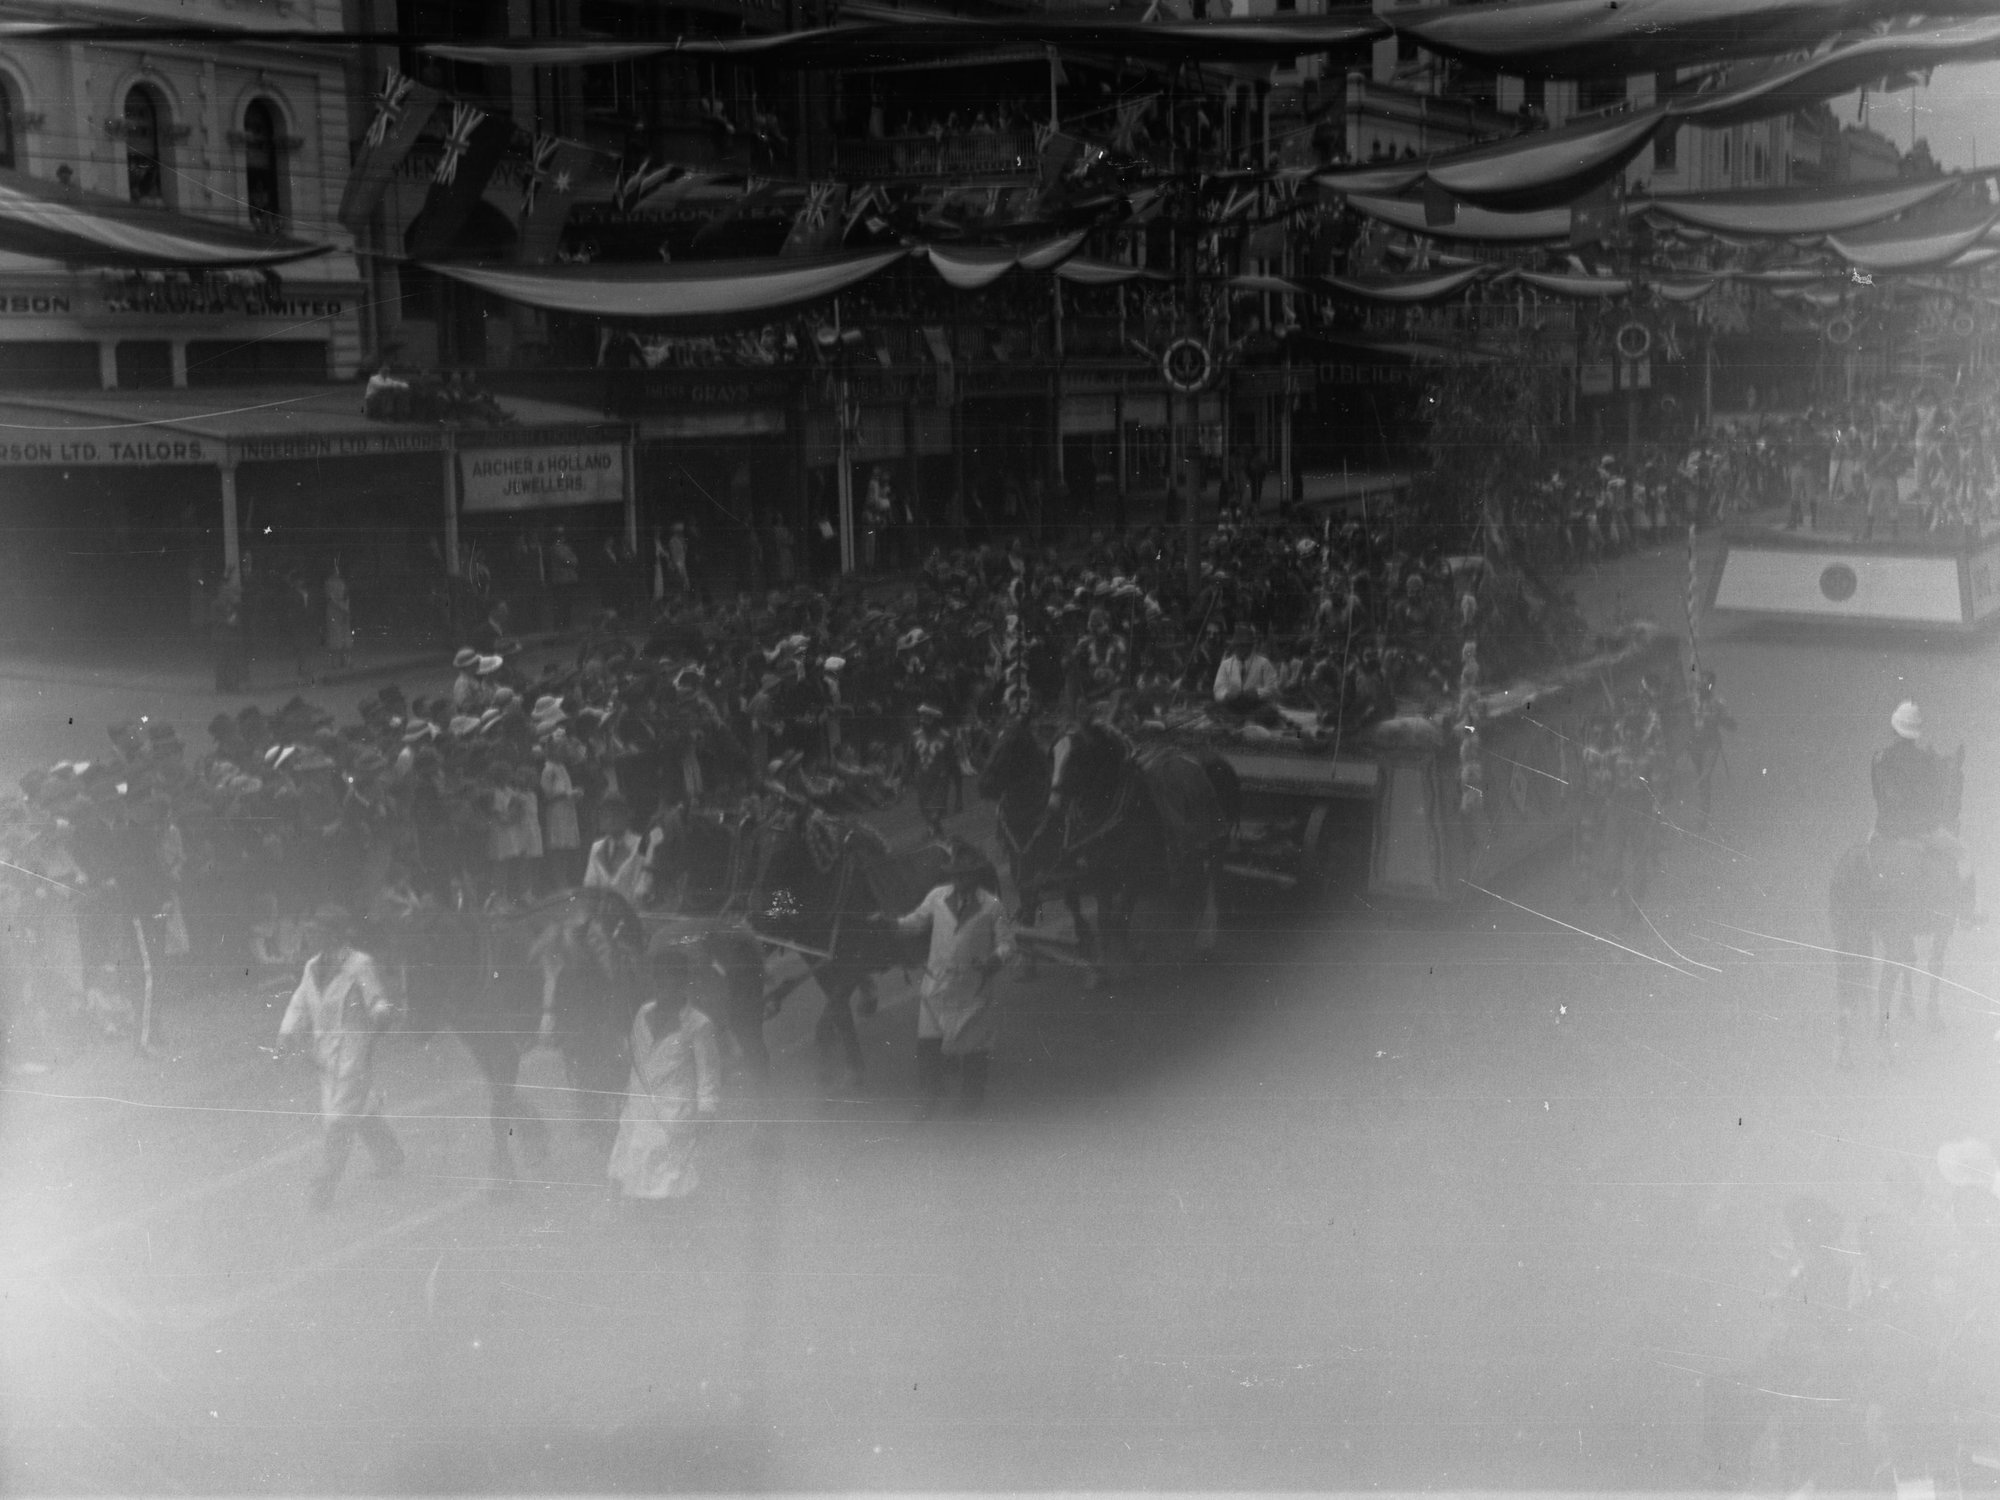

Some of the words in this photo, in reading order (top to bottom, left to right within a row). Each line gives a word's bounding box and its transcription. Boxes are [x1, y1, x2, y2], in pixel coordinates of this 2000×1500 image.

[246, 299, 341, 315] LIMITED
[472, 457, 534, 478] ARCHER
[547, 453, 613, 473] HOLLAND
